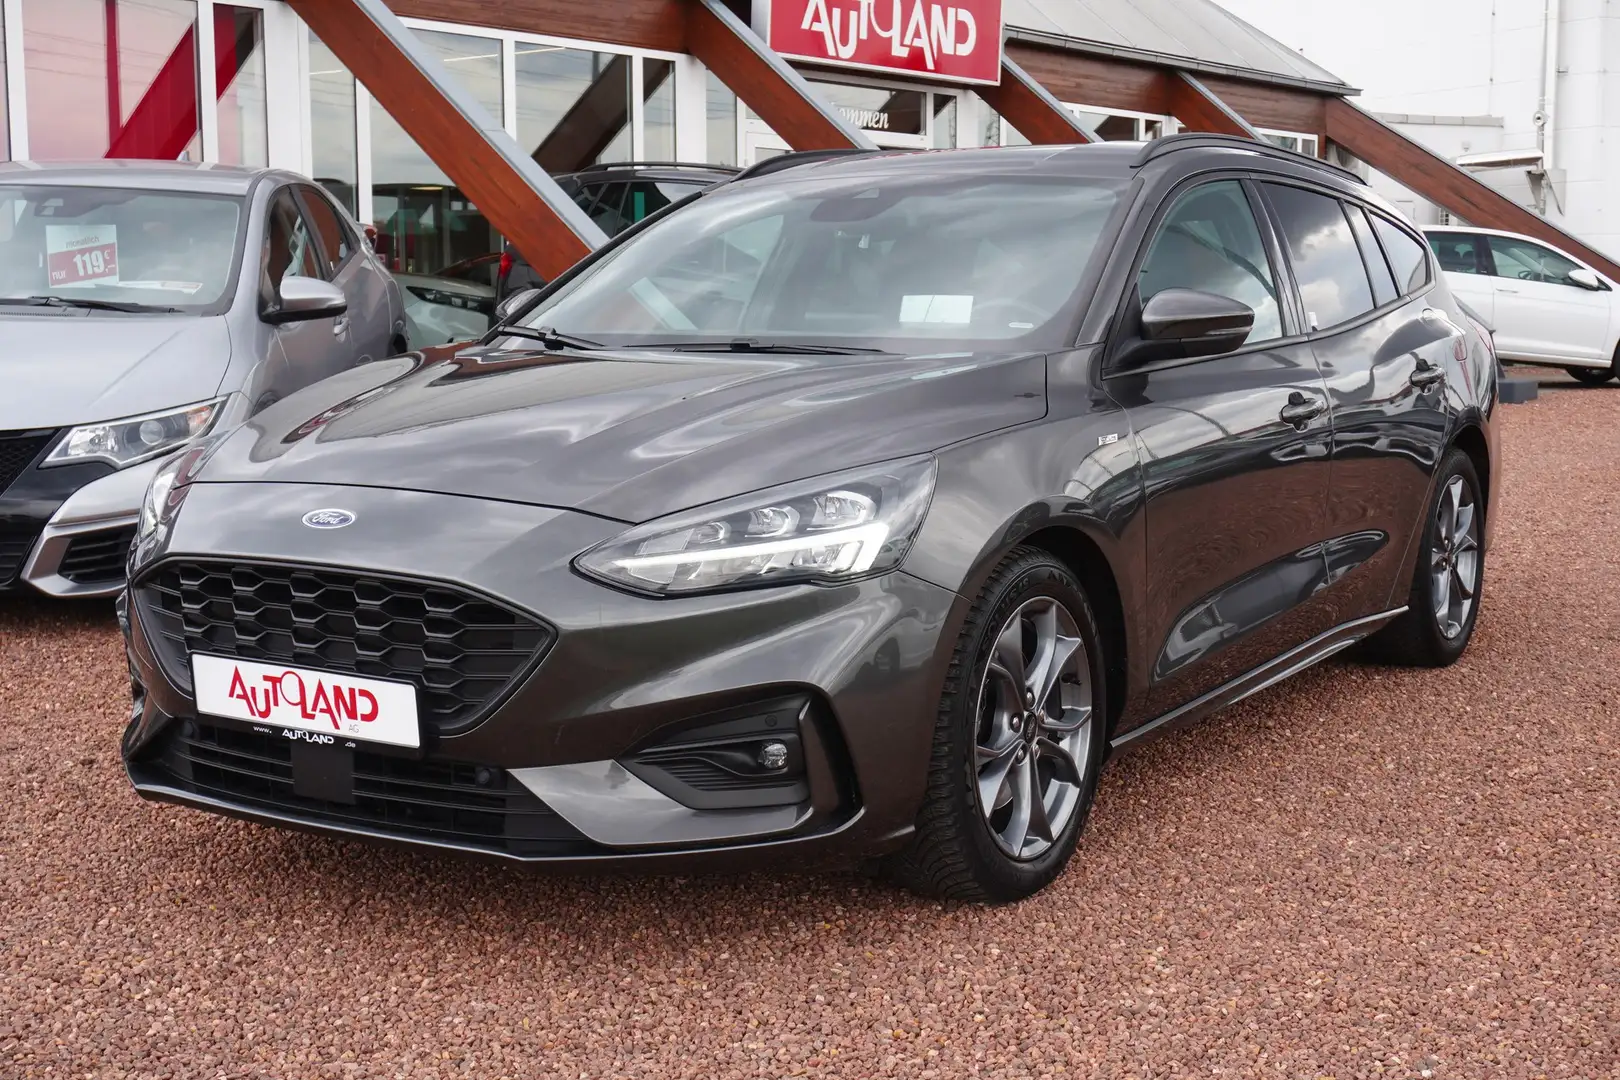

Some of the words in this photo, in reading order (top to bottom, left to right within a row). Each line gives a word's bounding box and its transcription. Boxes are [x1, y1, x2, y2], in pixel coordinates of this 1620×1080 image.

[801, 0, 977, 70] AUTOLAND
[51, 269, 66, 280] nur
[311, 511, 345, 524] Ford
[228, 665, 379, 730] AUTOLAND
[348, 723, 360, 734] AG
[282, 729, 335, 744] AUTOLAND
